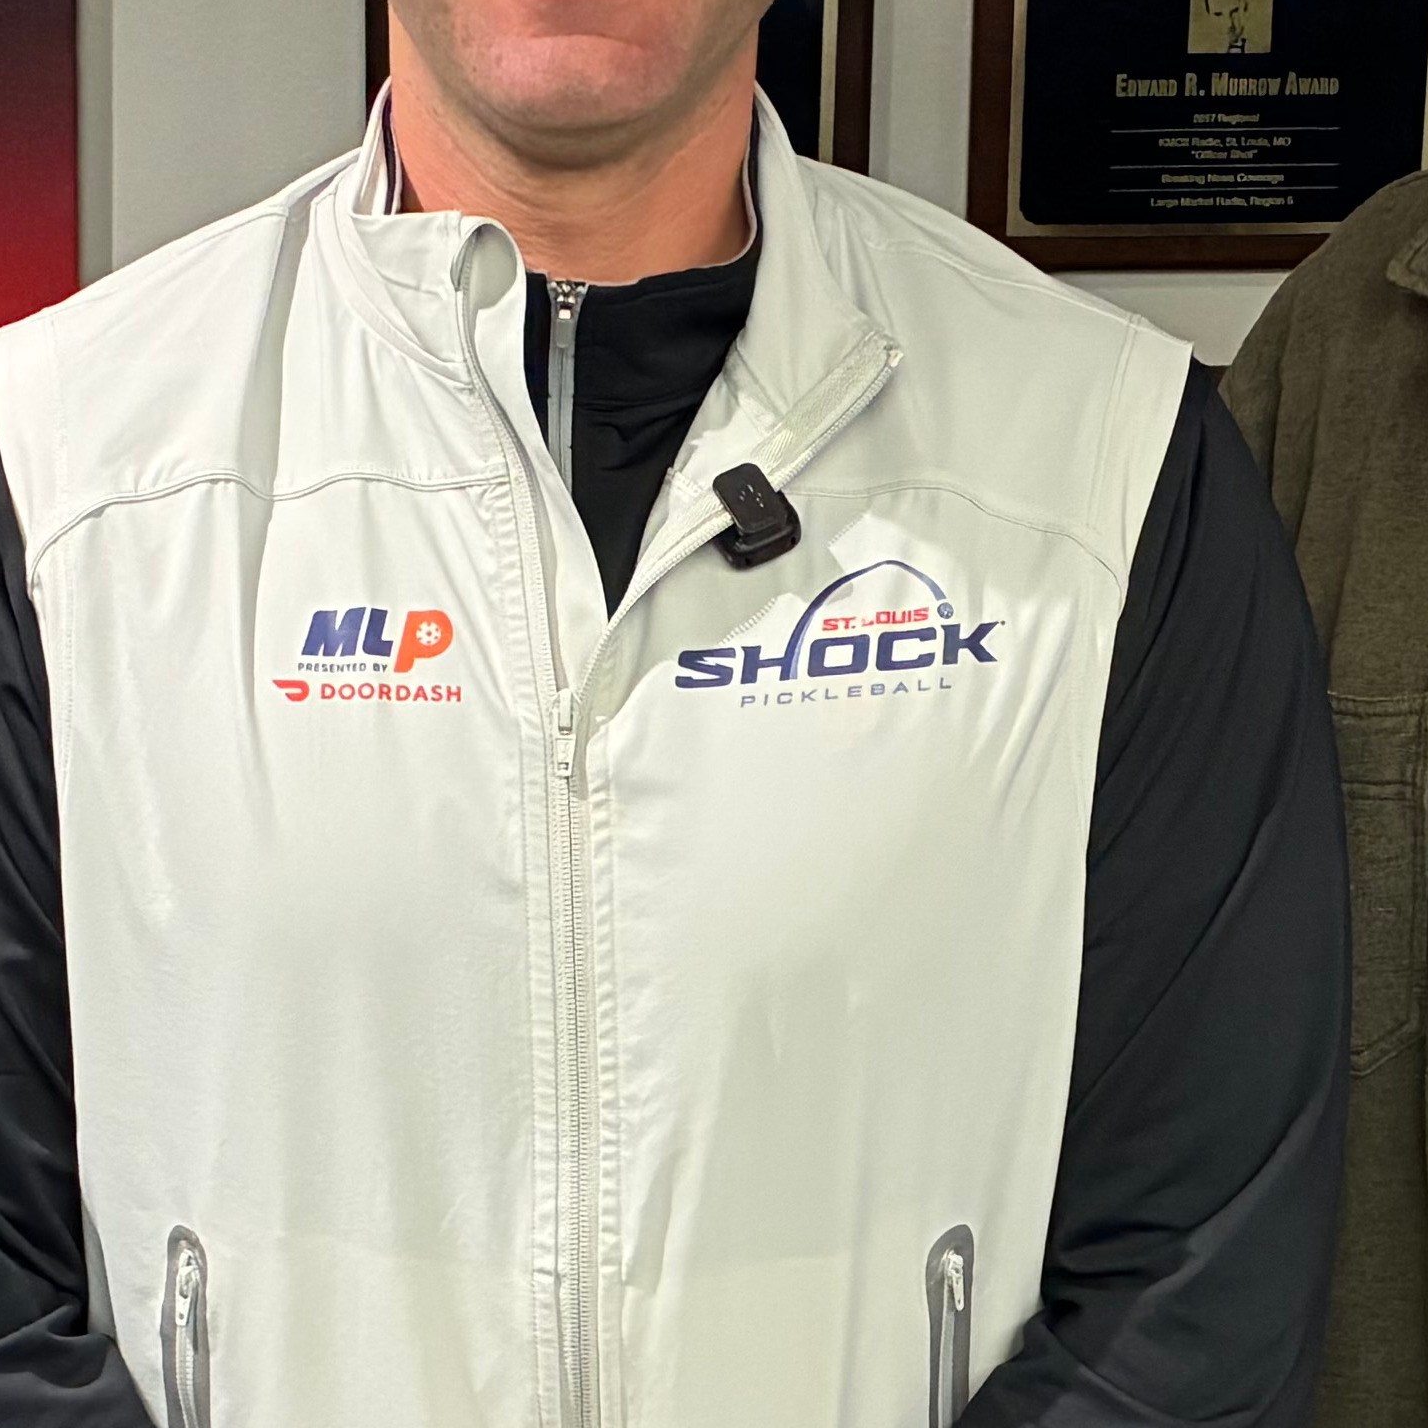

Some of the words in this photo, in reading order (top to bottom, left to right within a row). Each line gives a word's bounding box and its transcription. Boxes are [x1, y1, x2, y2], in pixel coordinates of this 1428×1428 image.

[1185, 73, 1205, 96] R.
[822, 616, 857, 632] ST.
[862, 607, 929, 627] LOUIS
[301, 607, 454, 673] MLP
[675, 620, 1002, 689] SHOCK
[298, 662, 366, 673] PRESENTED
[373, 662, 388, 673] BY
[320, 682, 462, 702] DOORDASH
[740, 676, 952, 708] PICKLEBALL
